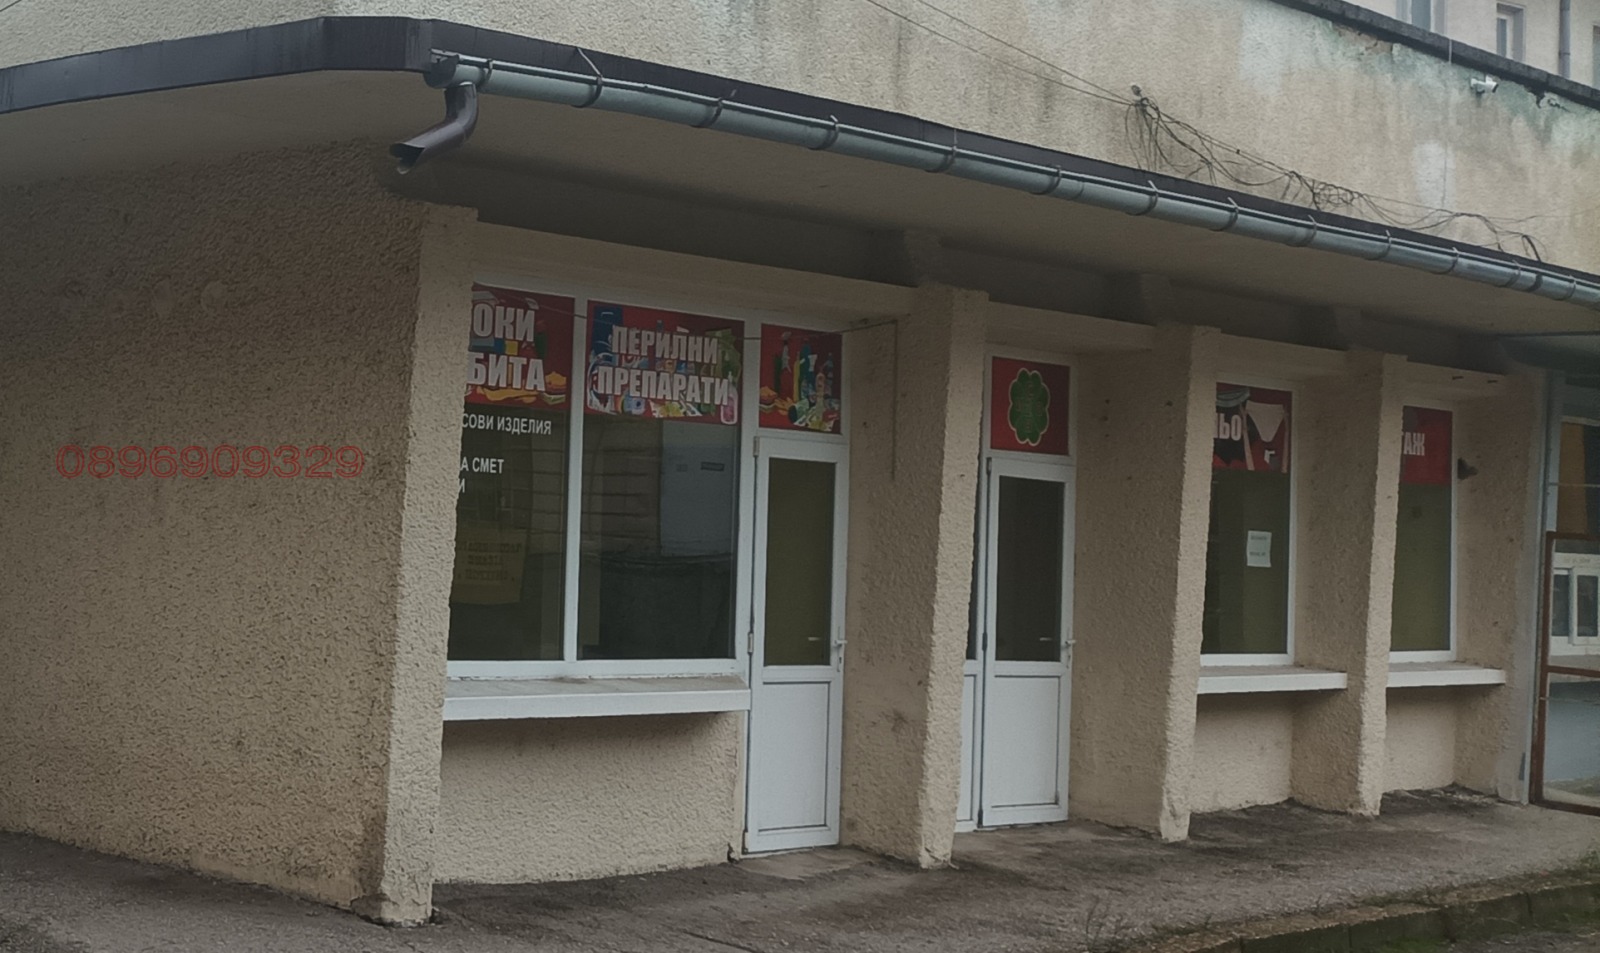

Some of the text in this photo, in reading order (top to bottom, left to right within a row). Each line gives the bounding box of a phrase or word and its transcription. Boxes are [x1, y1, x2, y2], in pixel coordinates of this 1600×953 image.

[472, 303, 536, 342] ОКИ
[612, 325, 718, 365] ПЕРИЛНИ
[467, 352, 546, 392] БИТА
[597, 366, 729, 406] ПРЕПАРАТИ
[461, 413, 552, 435] СОВИ ИЗДЕЛИЯ
[472, 457, 504, 474] СМЕТ
